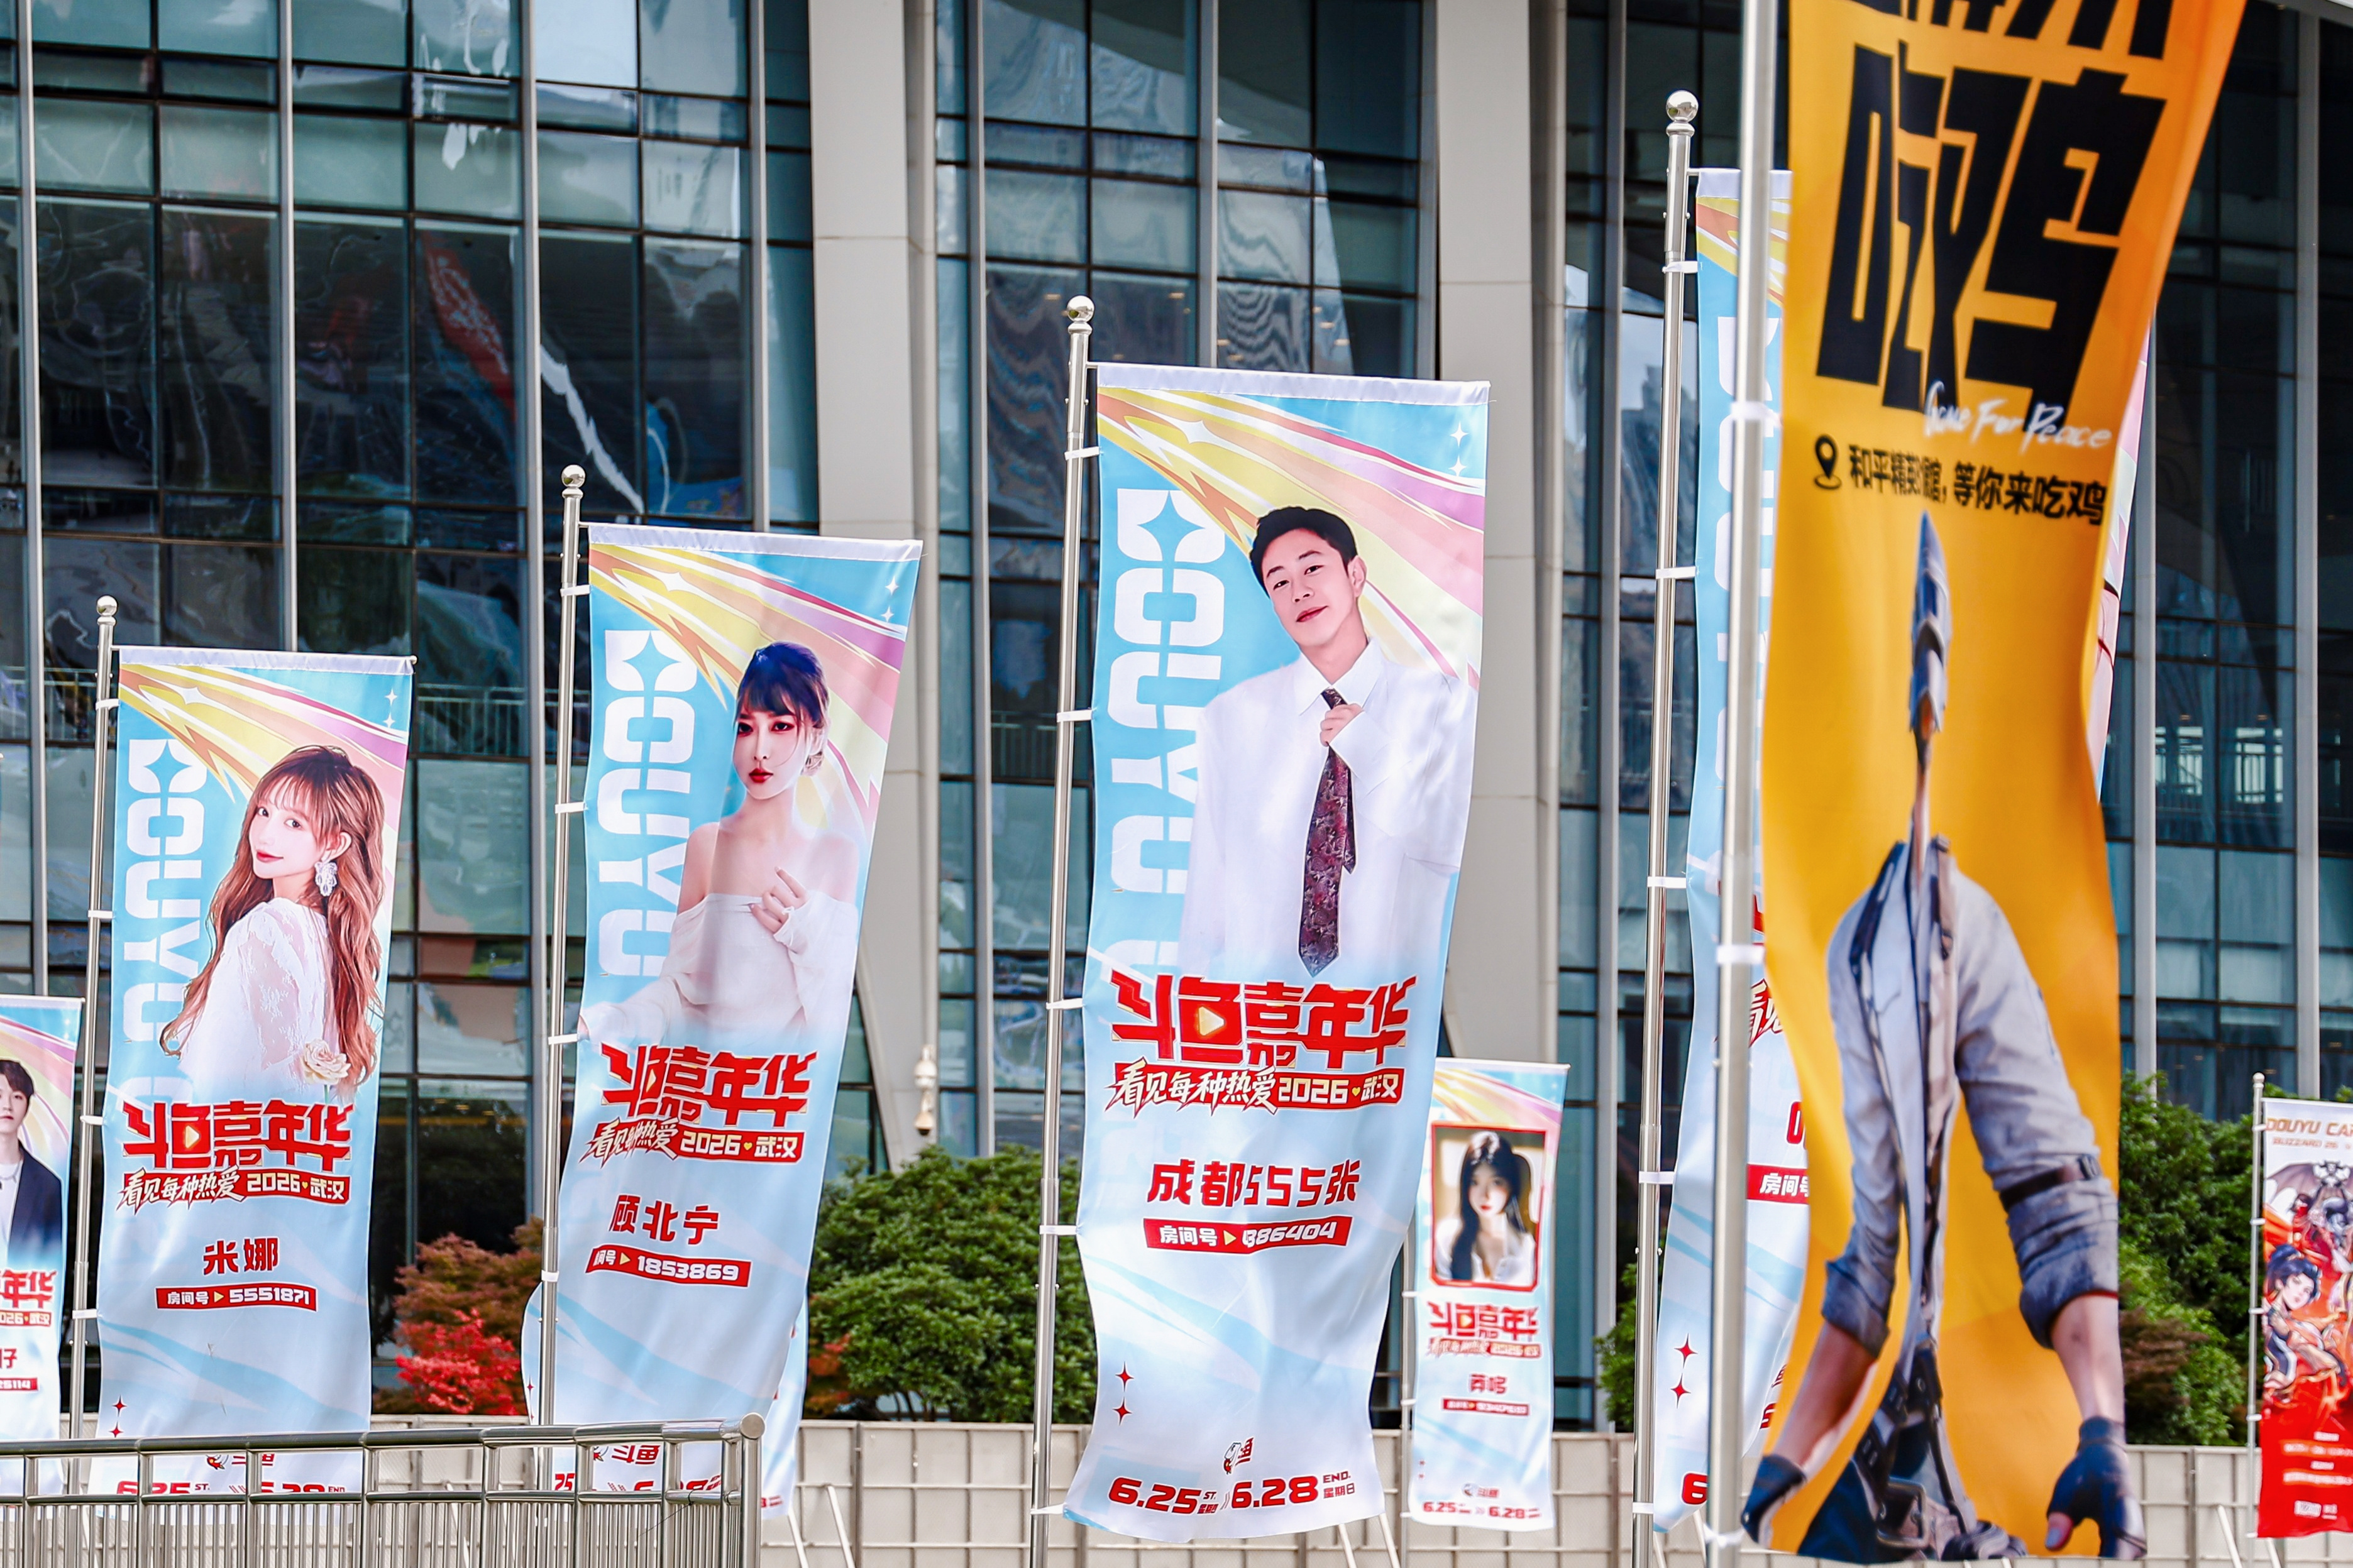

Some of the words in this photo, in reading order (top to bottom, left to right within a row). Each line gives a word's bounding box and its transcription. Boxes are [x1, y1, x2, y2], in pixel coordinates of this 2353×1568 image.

[1968, 398, 2025, 445] For
[2019, 402, 2113, 454] Peace
[1110, 969, 1417, 1070] 斗鱼嘉年华
[1106, 1058, 1277, 1116] 看见每种热爱
[1279, 1077, 1349, 1104] 2026
[1360, 1074, 1399, 1102] 武汉
[123, 1099, 354, 1173] 斗鱼嘉年华
[680, 1131, 742, 1155] 2026
[754, 1136, 798, 1158] 武汉
[119, 1166, 245, 1211] 看见每种热爱
[247, 1173, 301, 1193] 2026
[310, 1177, 344, 1200] 武汉
[1147, 1159, 1360, 1207] 成都555张
[1160, 1225, 1218, 1247] 房间号
[203, 1237, 278, 1275] 米娜
[637, 1255, 739, 1281] 1853869
[167, 1291, 209, 1305] 房间号
[229, 1287, 309, 1305] 5551871
[1109, 1478, 1201, 1515] 6.25
[1231, 1476, 1318, 1509] 6.28
[1323, 1483, 1356, 1499] 星期日
